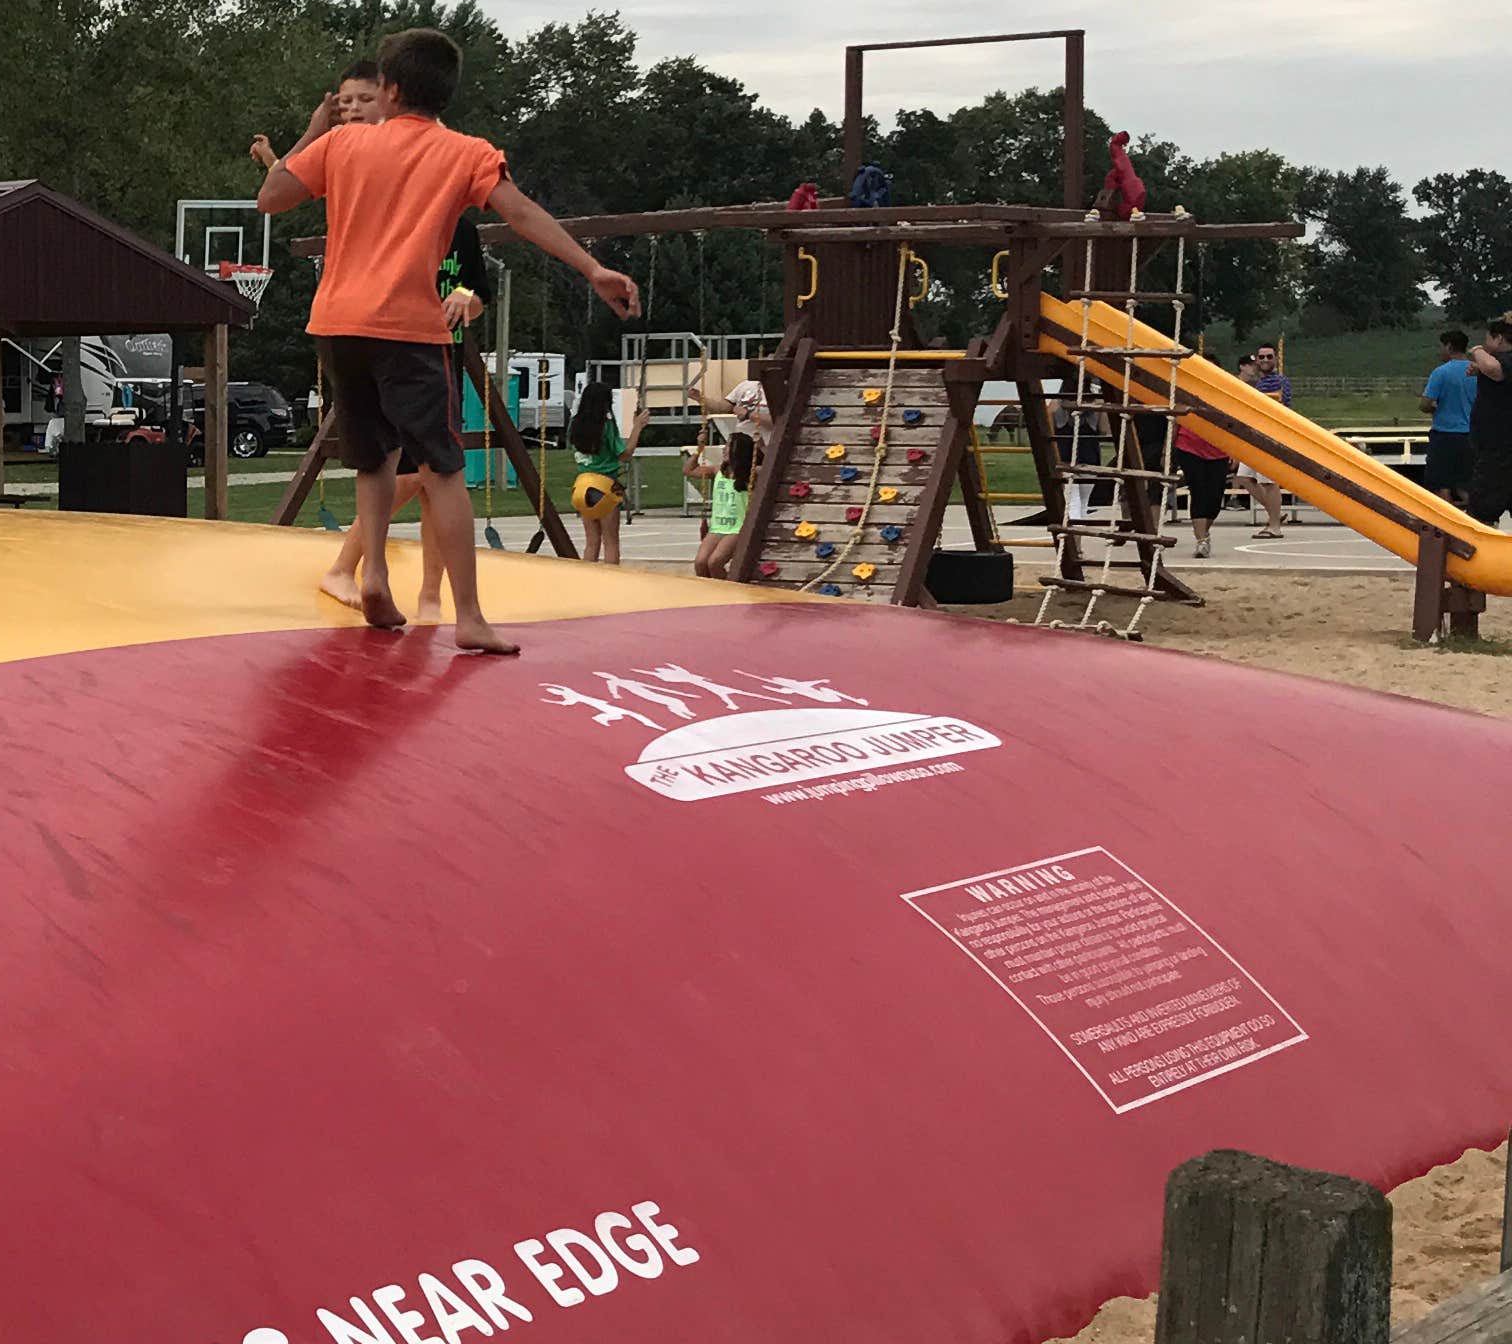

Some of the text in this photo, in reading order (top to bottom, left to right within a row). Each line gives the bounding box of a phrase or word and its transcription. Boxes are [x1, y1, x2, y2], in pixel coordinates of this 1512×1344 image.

[650, 723, 985, 788] THE KANGAROO JUMPER
[964, 865, 1076, 903] WARNING
[514, 1201, 700, 1307] EDGE
